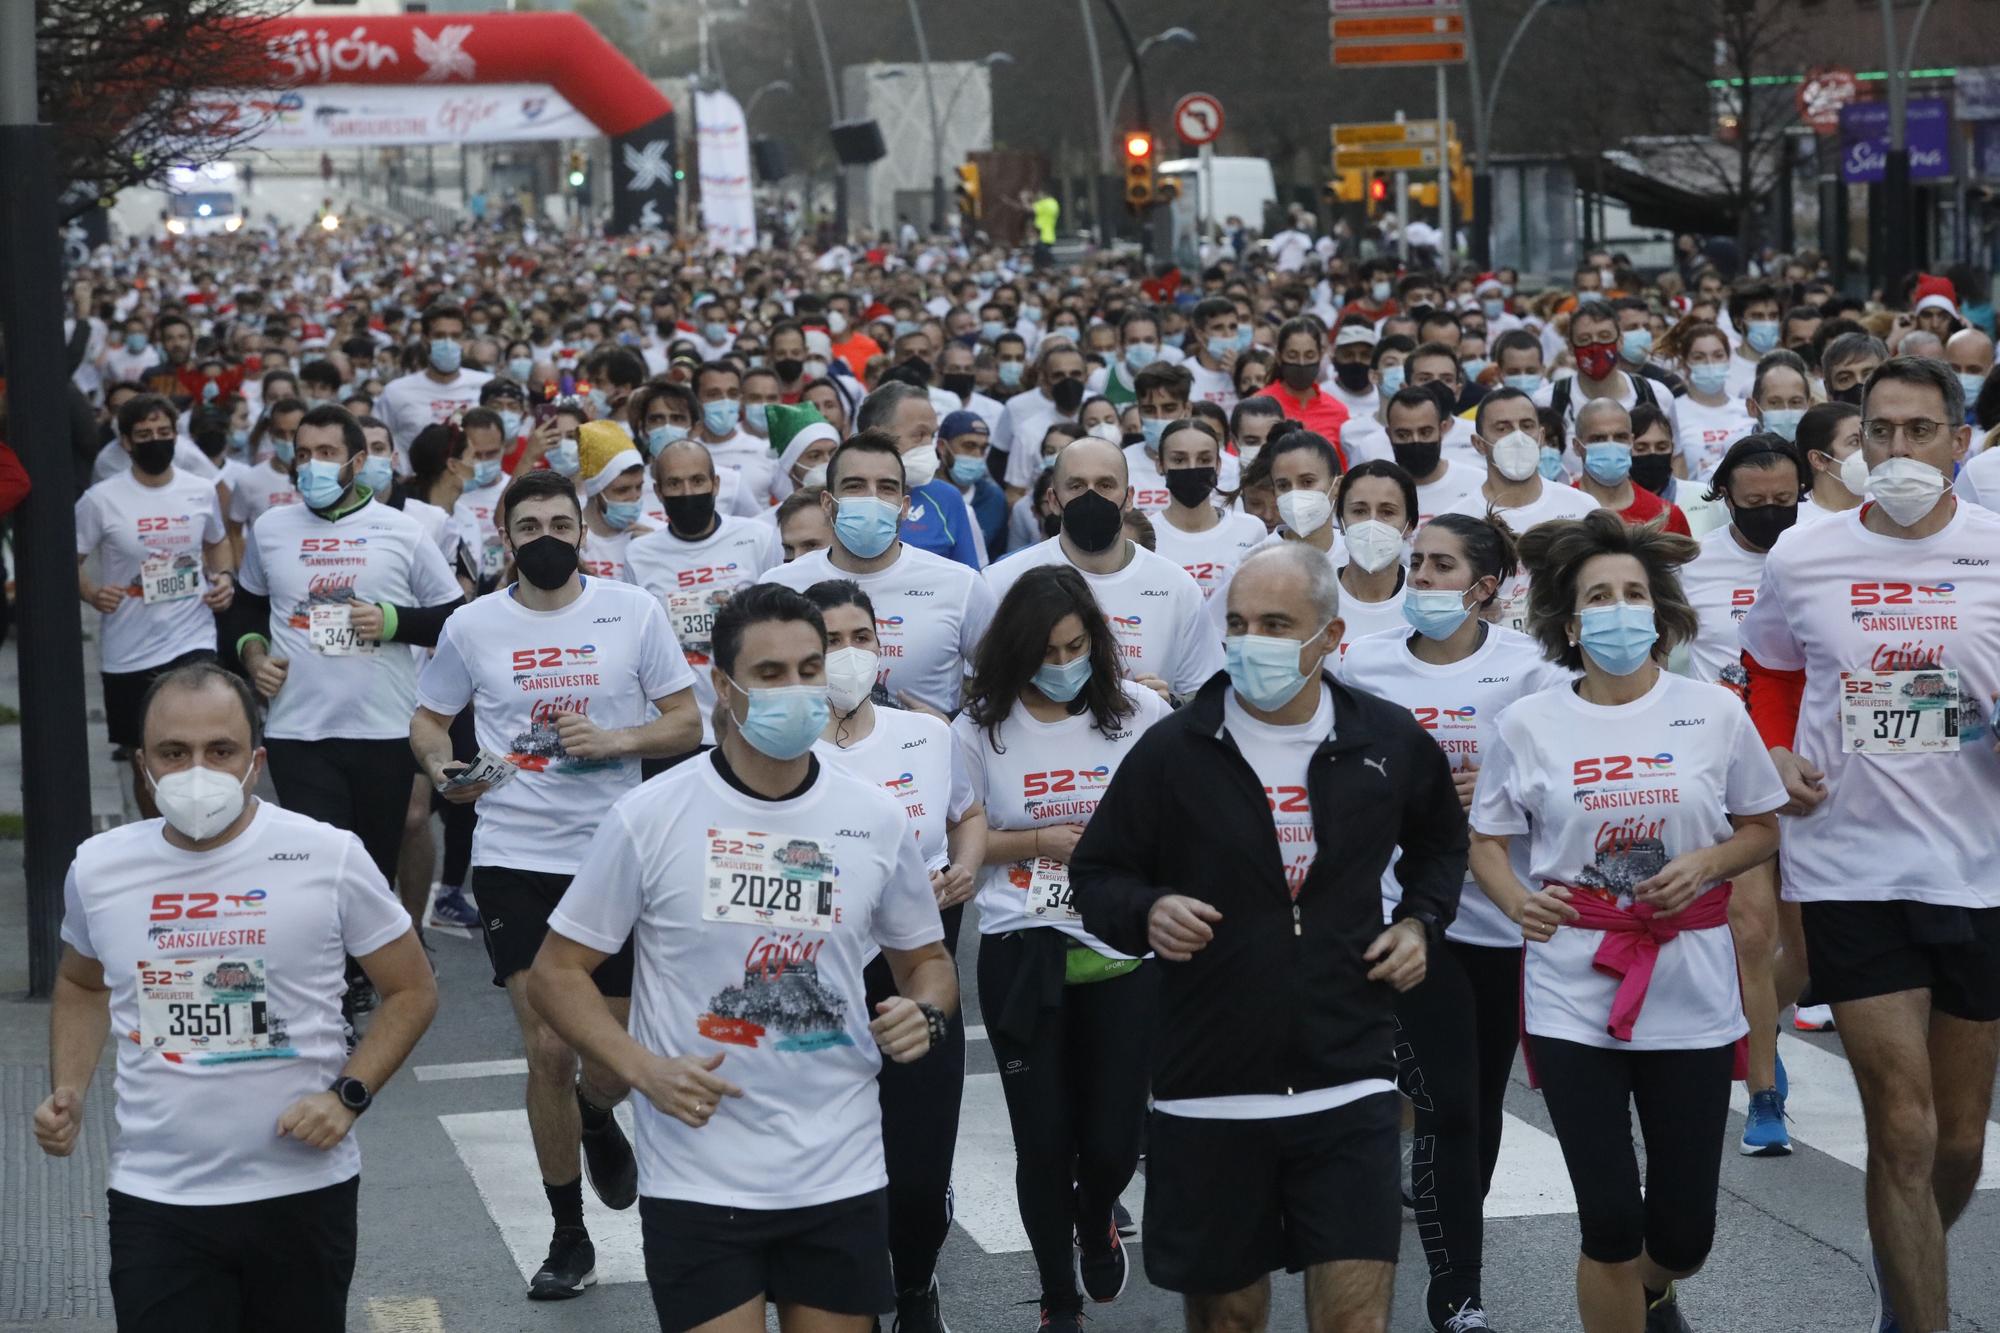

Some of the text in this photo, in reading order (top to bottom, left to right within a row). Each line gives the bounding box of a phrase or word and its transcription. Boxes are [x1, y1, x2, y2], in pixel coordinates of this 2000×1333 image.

[1138, 490, 1169, 504] 52
[138, 517, 169, 532] 52
[301, 539, 340, 552] 52
[156, 576, 186, 595] 1808
[677, 567, 714, 588] 52
[1851, 583, 1912, 606] 52
[1862, 616, 1958, 631] SANSILVESTRE
[325, 628, 366, 647] 347
[513, 647, 562, 671] 52
[522, 674, 600, 691] SANSILVESTRE
[1845, 681, 1873, 694] 52
[1408, 707, 1438, 729] 2
[1873, 710, 1921, 739] 377
[1435, 740, 1479, 754] ESTRE
[1573, 755, 1633, 786] 52
[1024, 769, 1076, 797] 52
[1583, 788, 1680, 811] SANSILVESTRE
[711, 839, 743, 855] 52
[715, 861, 763, 872] SANSILVESTRE
[1038, 859, 1063, 871] 52
[730, 873, 802, 912] 2028
[150, 893, 219, 921] 52
[157, 929, 266, 950] SANSILVESTRE
[142, 971, 172, 985] 52
[148, 991, 194, 1000] SANSILVESTRE
[168, 1003, 231, 1036] 3551
